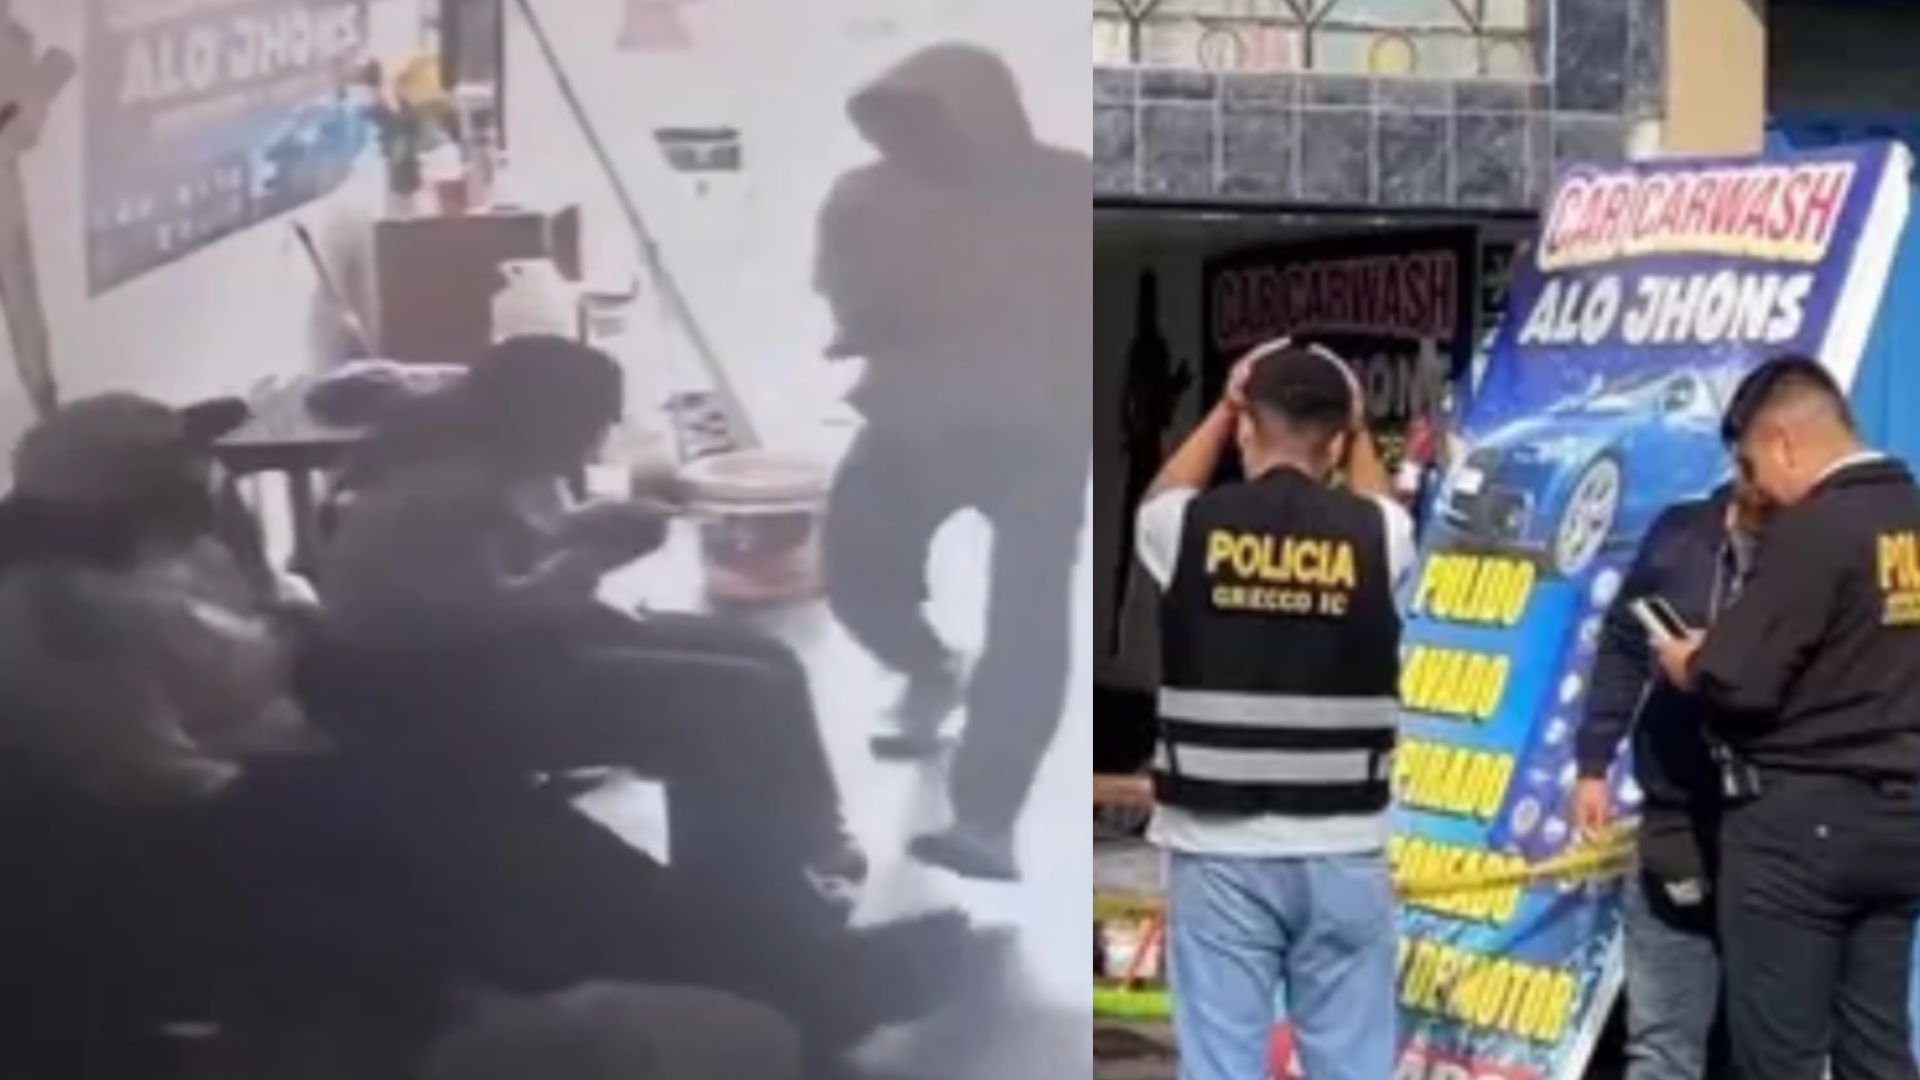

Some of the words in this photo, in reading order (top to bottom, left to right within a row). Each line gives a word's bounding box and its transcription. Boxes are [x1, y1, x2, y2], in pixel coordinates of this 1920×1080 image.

[119, 25, 219, 104] ALO
[1547, 181, 1633, 253] CAR
[1634, 169, 1848, 246] CARWASH
[1284, 256, 1452, 333] CARWASH
[1517, 275, 1621, 345] ALO
[1621, 270, 1815, 345] JHONS
[1206, 529, 1356, 589] POLICIA
[1412, 552, 1536, 626] PULIDO
[1212, 583, 1313, 616] GRECCO
[1399, 643, 1511, 721] AVADO
[1389, 733, 1515, 819] PIRADO
[1455, 953, 1578, 1043] MOTOR
